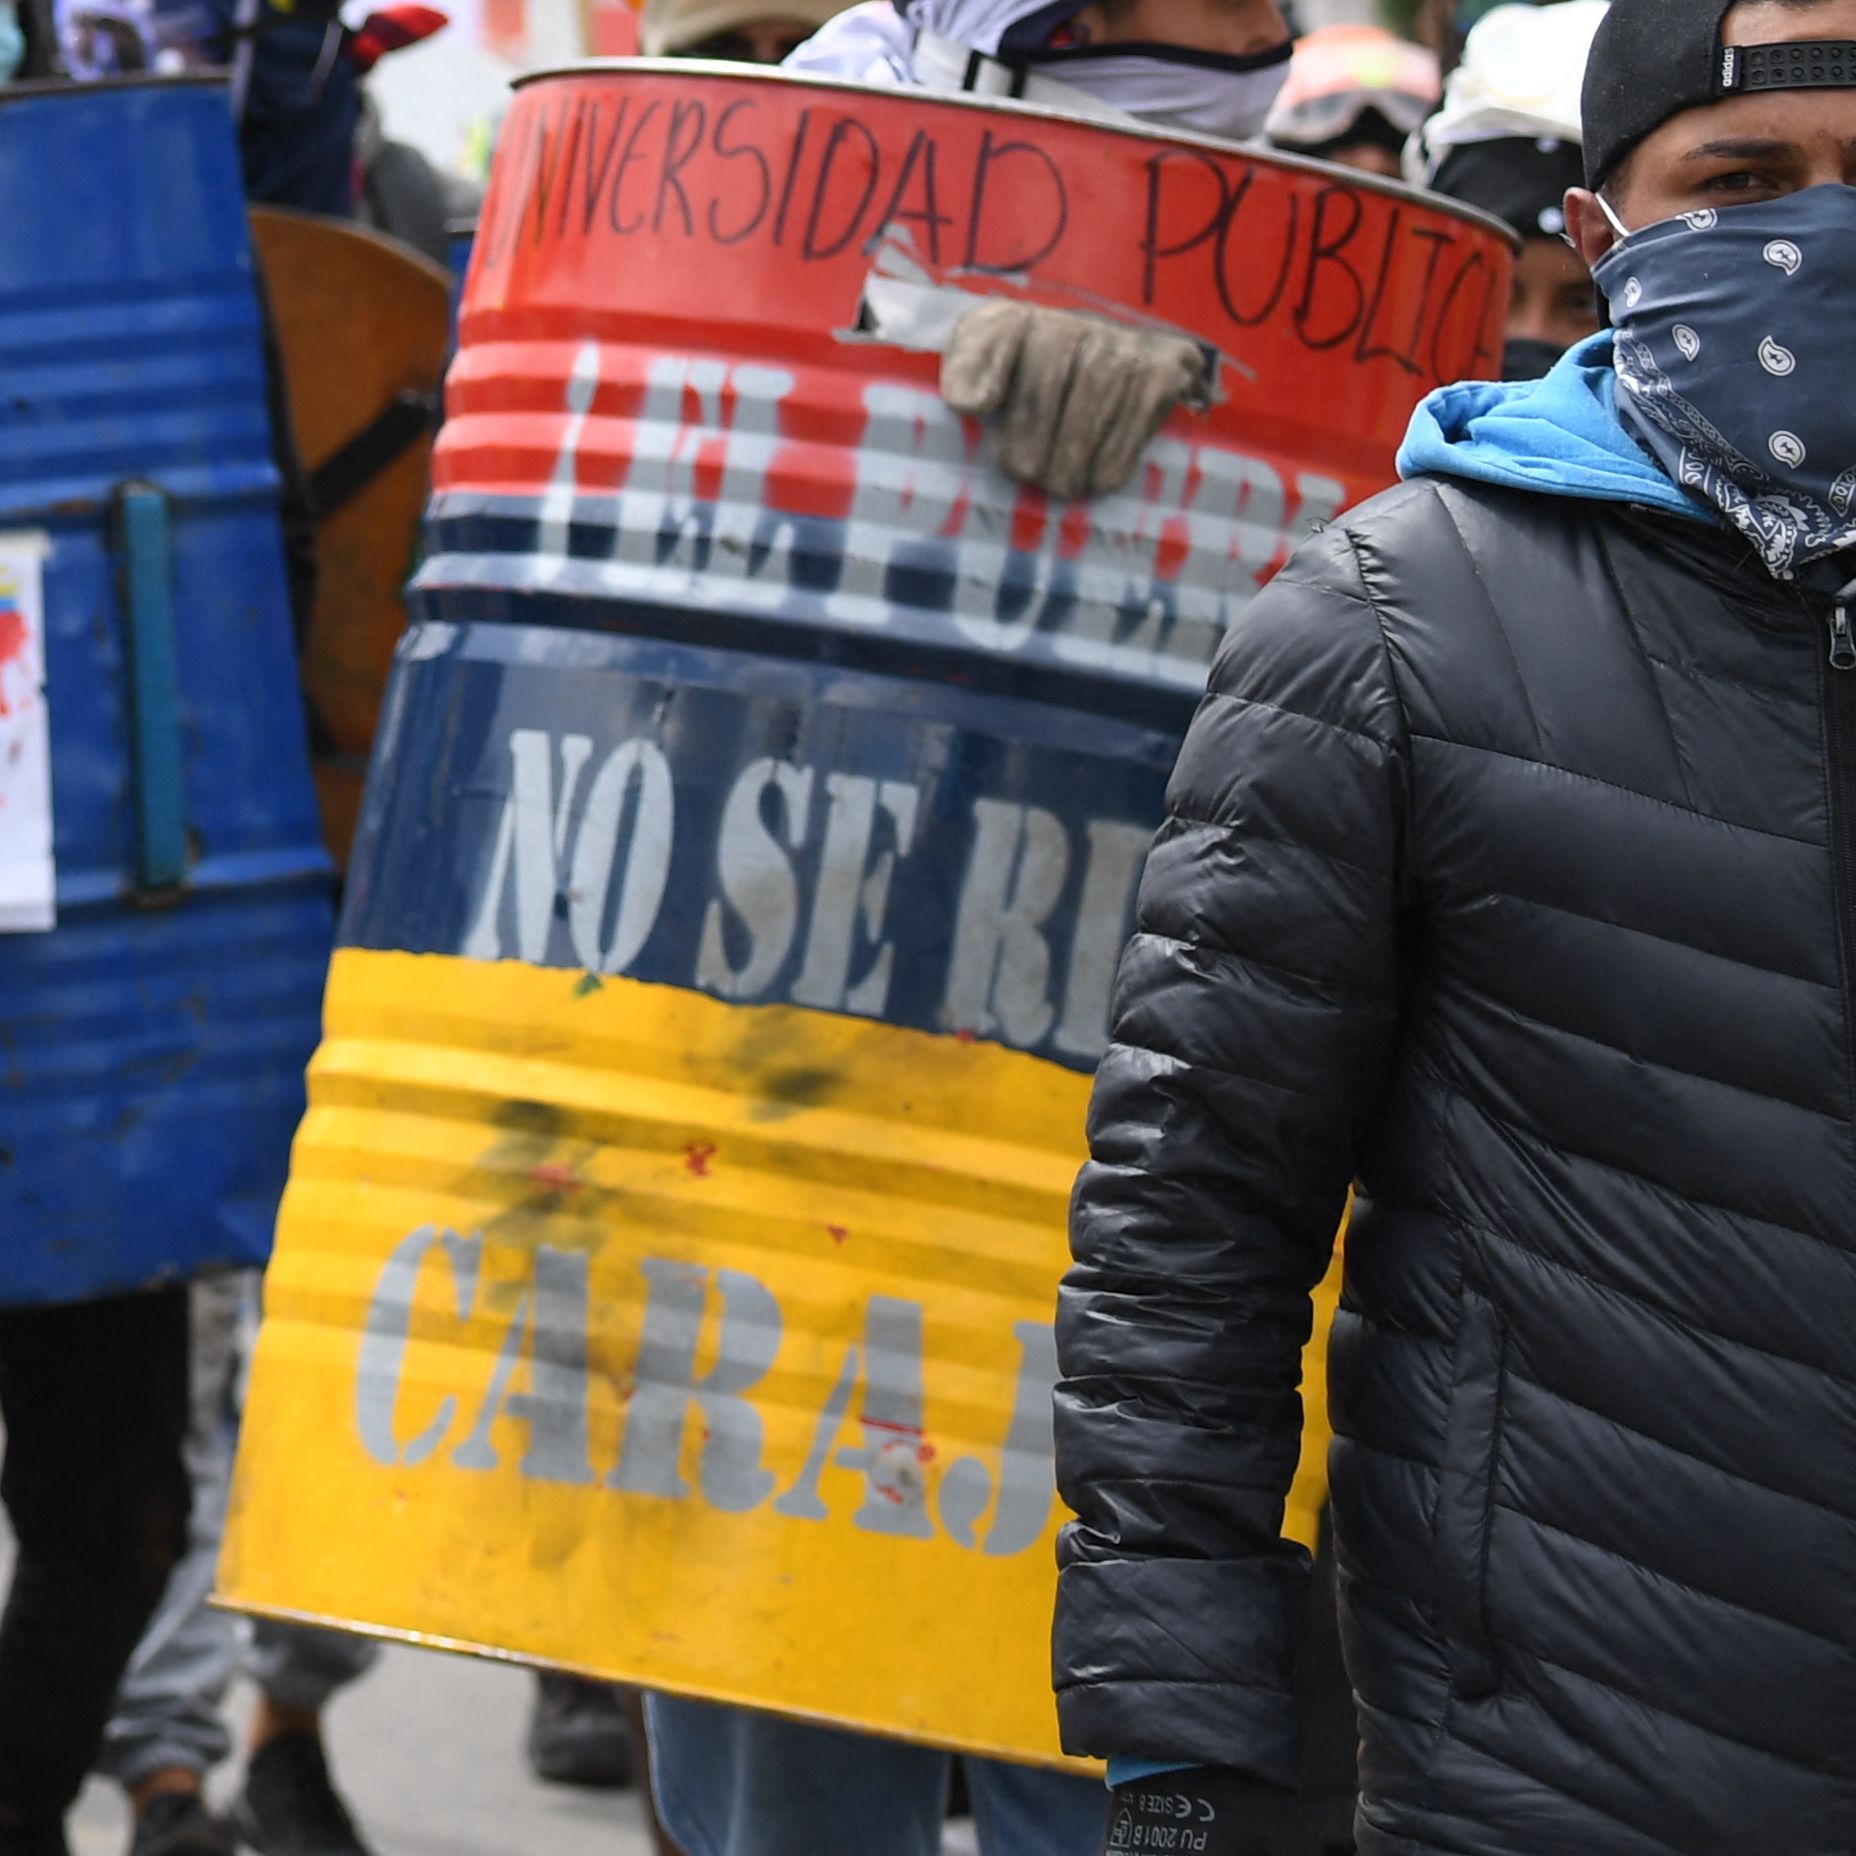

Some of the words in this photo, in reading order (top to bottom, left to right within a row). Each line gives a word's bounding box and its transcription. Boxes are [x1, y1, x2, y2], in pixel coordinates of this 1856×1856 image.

[1722, 47, 1734, 88] adidas
[465, 729, 677, 973] NO
[697, 756, 920, 1016] SE
[1146, 1794, 1174, 1815] SIZE
[1181, 1828, 1208, 1851] PU
